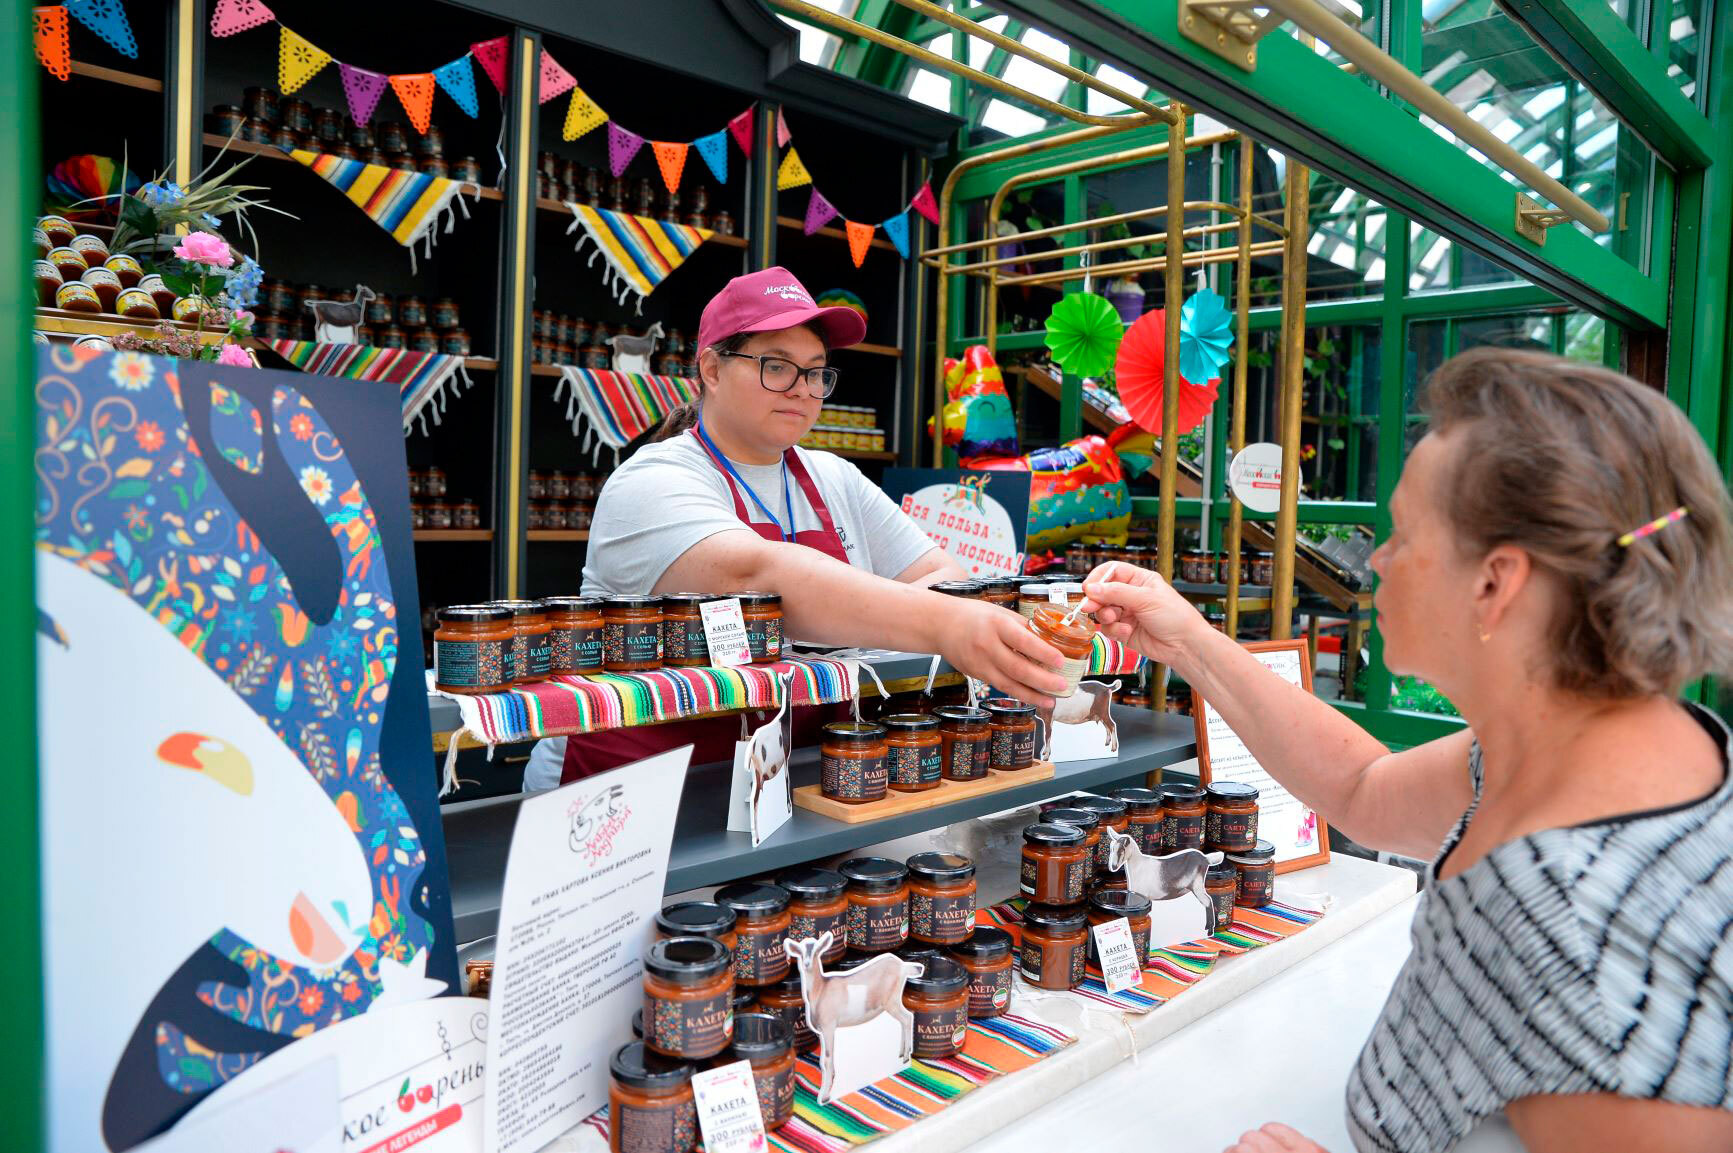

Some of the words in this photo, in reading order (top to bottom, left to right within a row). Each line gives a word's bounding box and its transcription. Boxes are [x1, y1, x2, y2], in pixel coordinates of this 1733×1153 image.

[712, 623, 737, 632] КАХЕТА
[627, 635, 657, 644] КАХЕТА
[688, 633, 705, 641] КАХ
[747, 632, 766, 640] ХЕТА
[530, 646, 552, 657] КАХЕТ
[713, 643, 725, 652] 300
[1014, 742, 1033, 750] КАХЕТ
[921, 756, 942, 766] КАХЕТ
[935, 909, 968, 919] КАХЕТА
[758, 944, 785, 958] КАХЕ
[1105, 943, 1128, 954] КАХЕТА
[1106, 966, 1118, 976] 300
[968, 985, 996, 993] АХЕТА
[917, 1023, 956, 1034] КАХЕТА
[711, 1096, 747, 1113] КАХЕТА
[710, 1130, 729, 1144] 300
